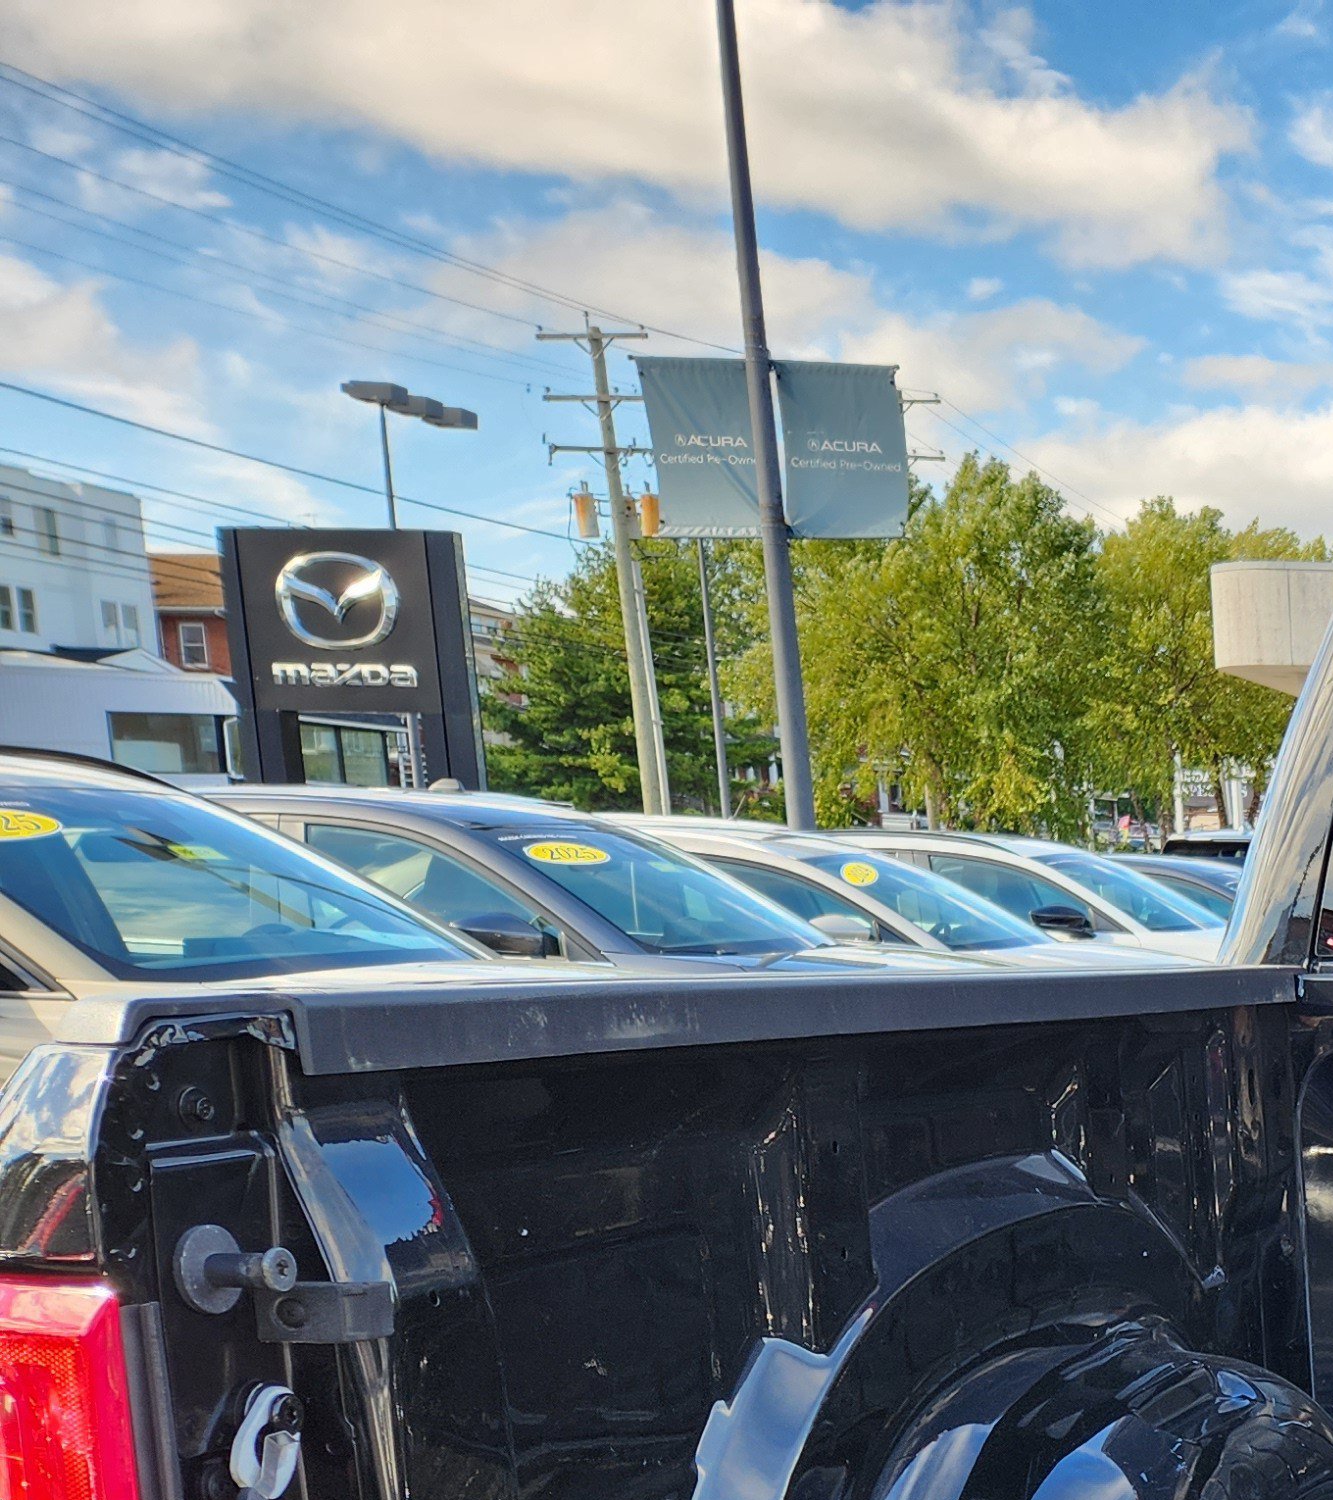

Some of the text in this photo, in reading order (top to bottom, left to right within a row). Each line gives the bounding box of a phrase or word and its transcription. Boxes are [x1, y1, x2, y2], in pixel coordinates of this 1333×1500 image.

[687, 434, 748, 448] ACURA
[820, 440, 883, 454] ACURA
[659, 453, 756, 465] Certified Pre-Own
[790, 457, 901, 472] Certified Pre-Owned
[541, 847, 598, 861] 2025
